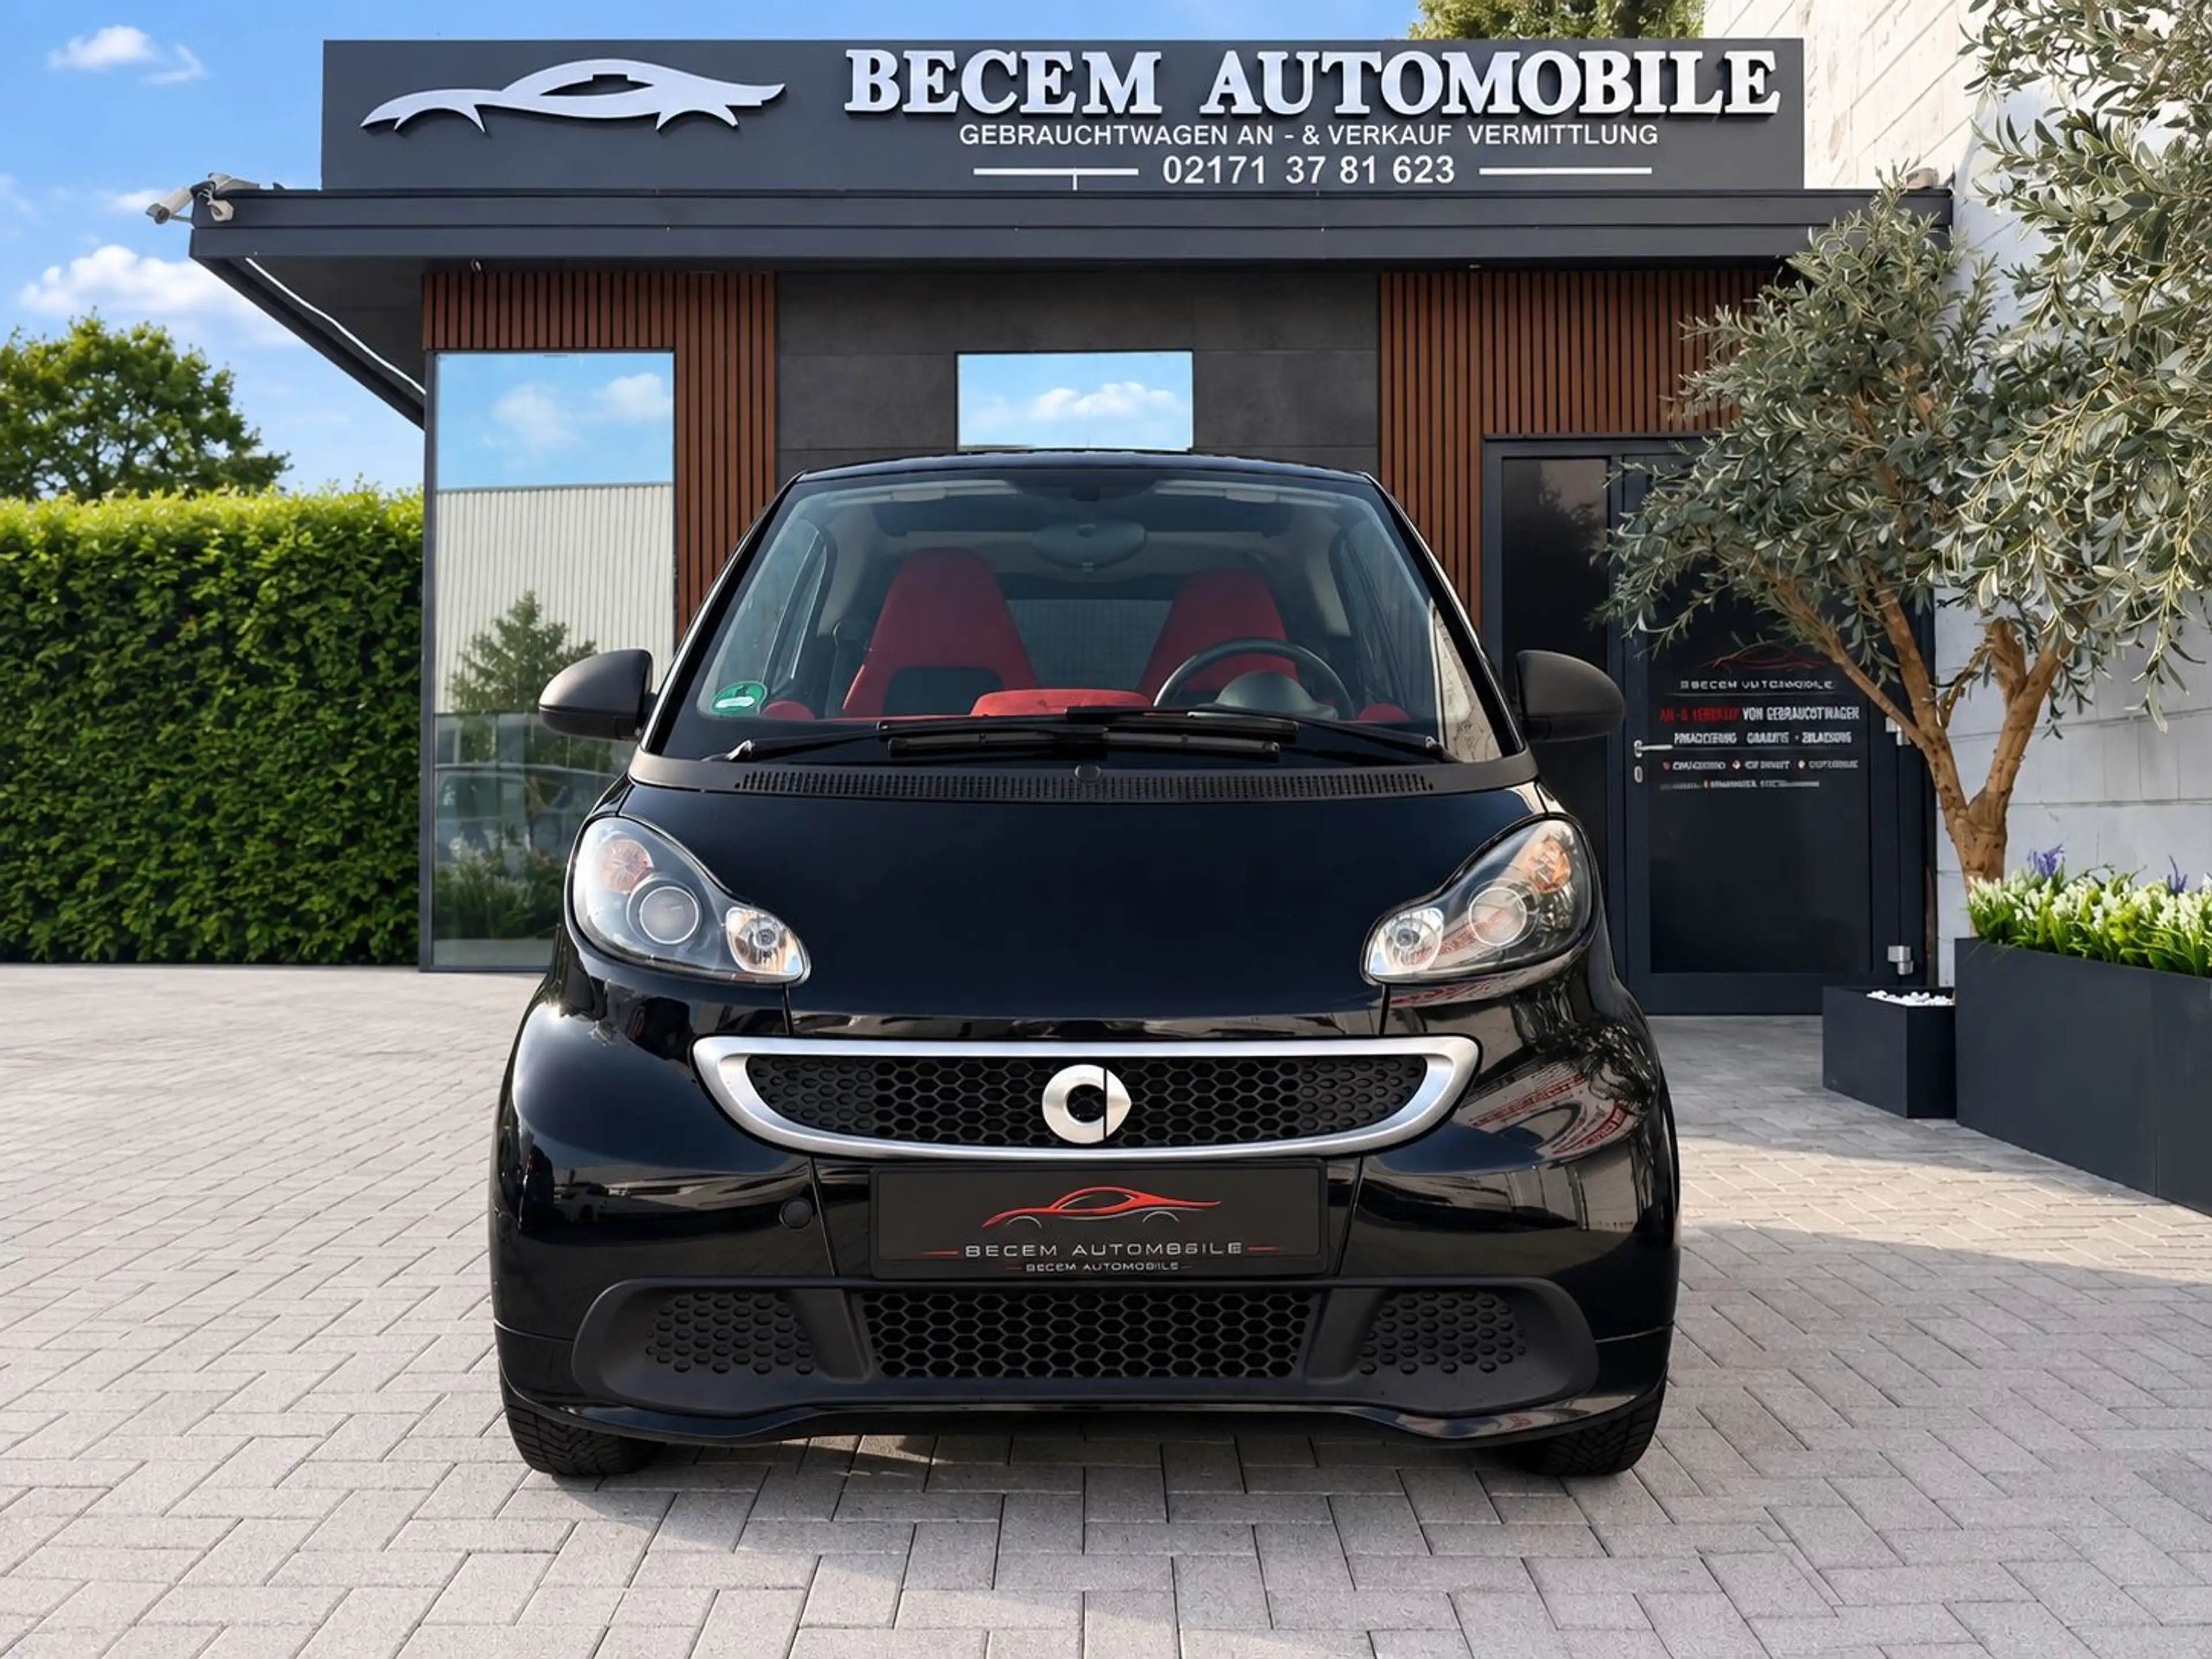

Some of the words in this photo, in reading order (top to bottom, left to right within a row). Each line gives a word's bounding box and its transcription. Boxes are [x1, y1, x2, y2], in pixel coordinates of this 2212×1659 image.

[844, 49, 1162, 113] BECEM
[1200, 50, 1781, 115] AUTOMOBILE
[960, 124, 1227, 145] GEBRAUCHTWAGEN
[1237, 124, 1273, 145] AN
[1302, 124, 1320, 145] &
[1328, 124, 1452, 145] VERKAUF
[1467, 124, 1658, 145] VERMITTLUNG
[1163, 155, 1264, 184] 02171
[1286, 155, 1326, 184] 37
[1339, 155, 1374, 184] 81
[1393, 155, 1455, 184] 623
[965, 1244, 1057, 1257] BECEM
